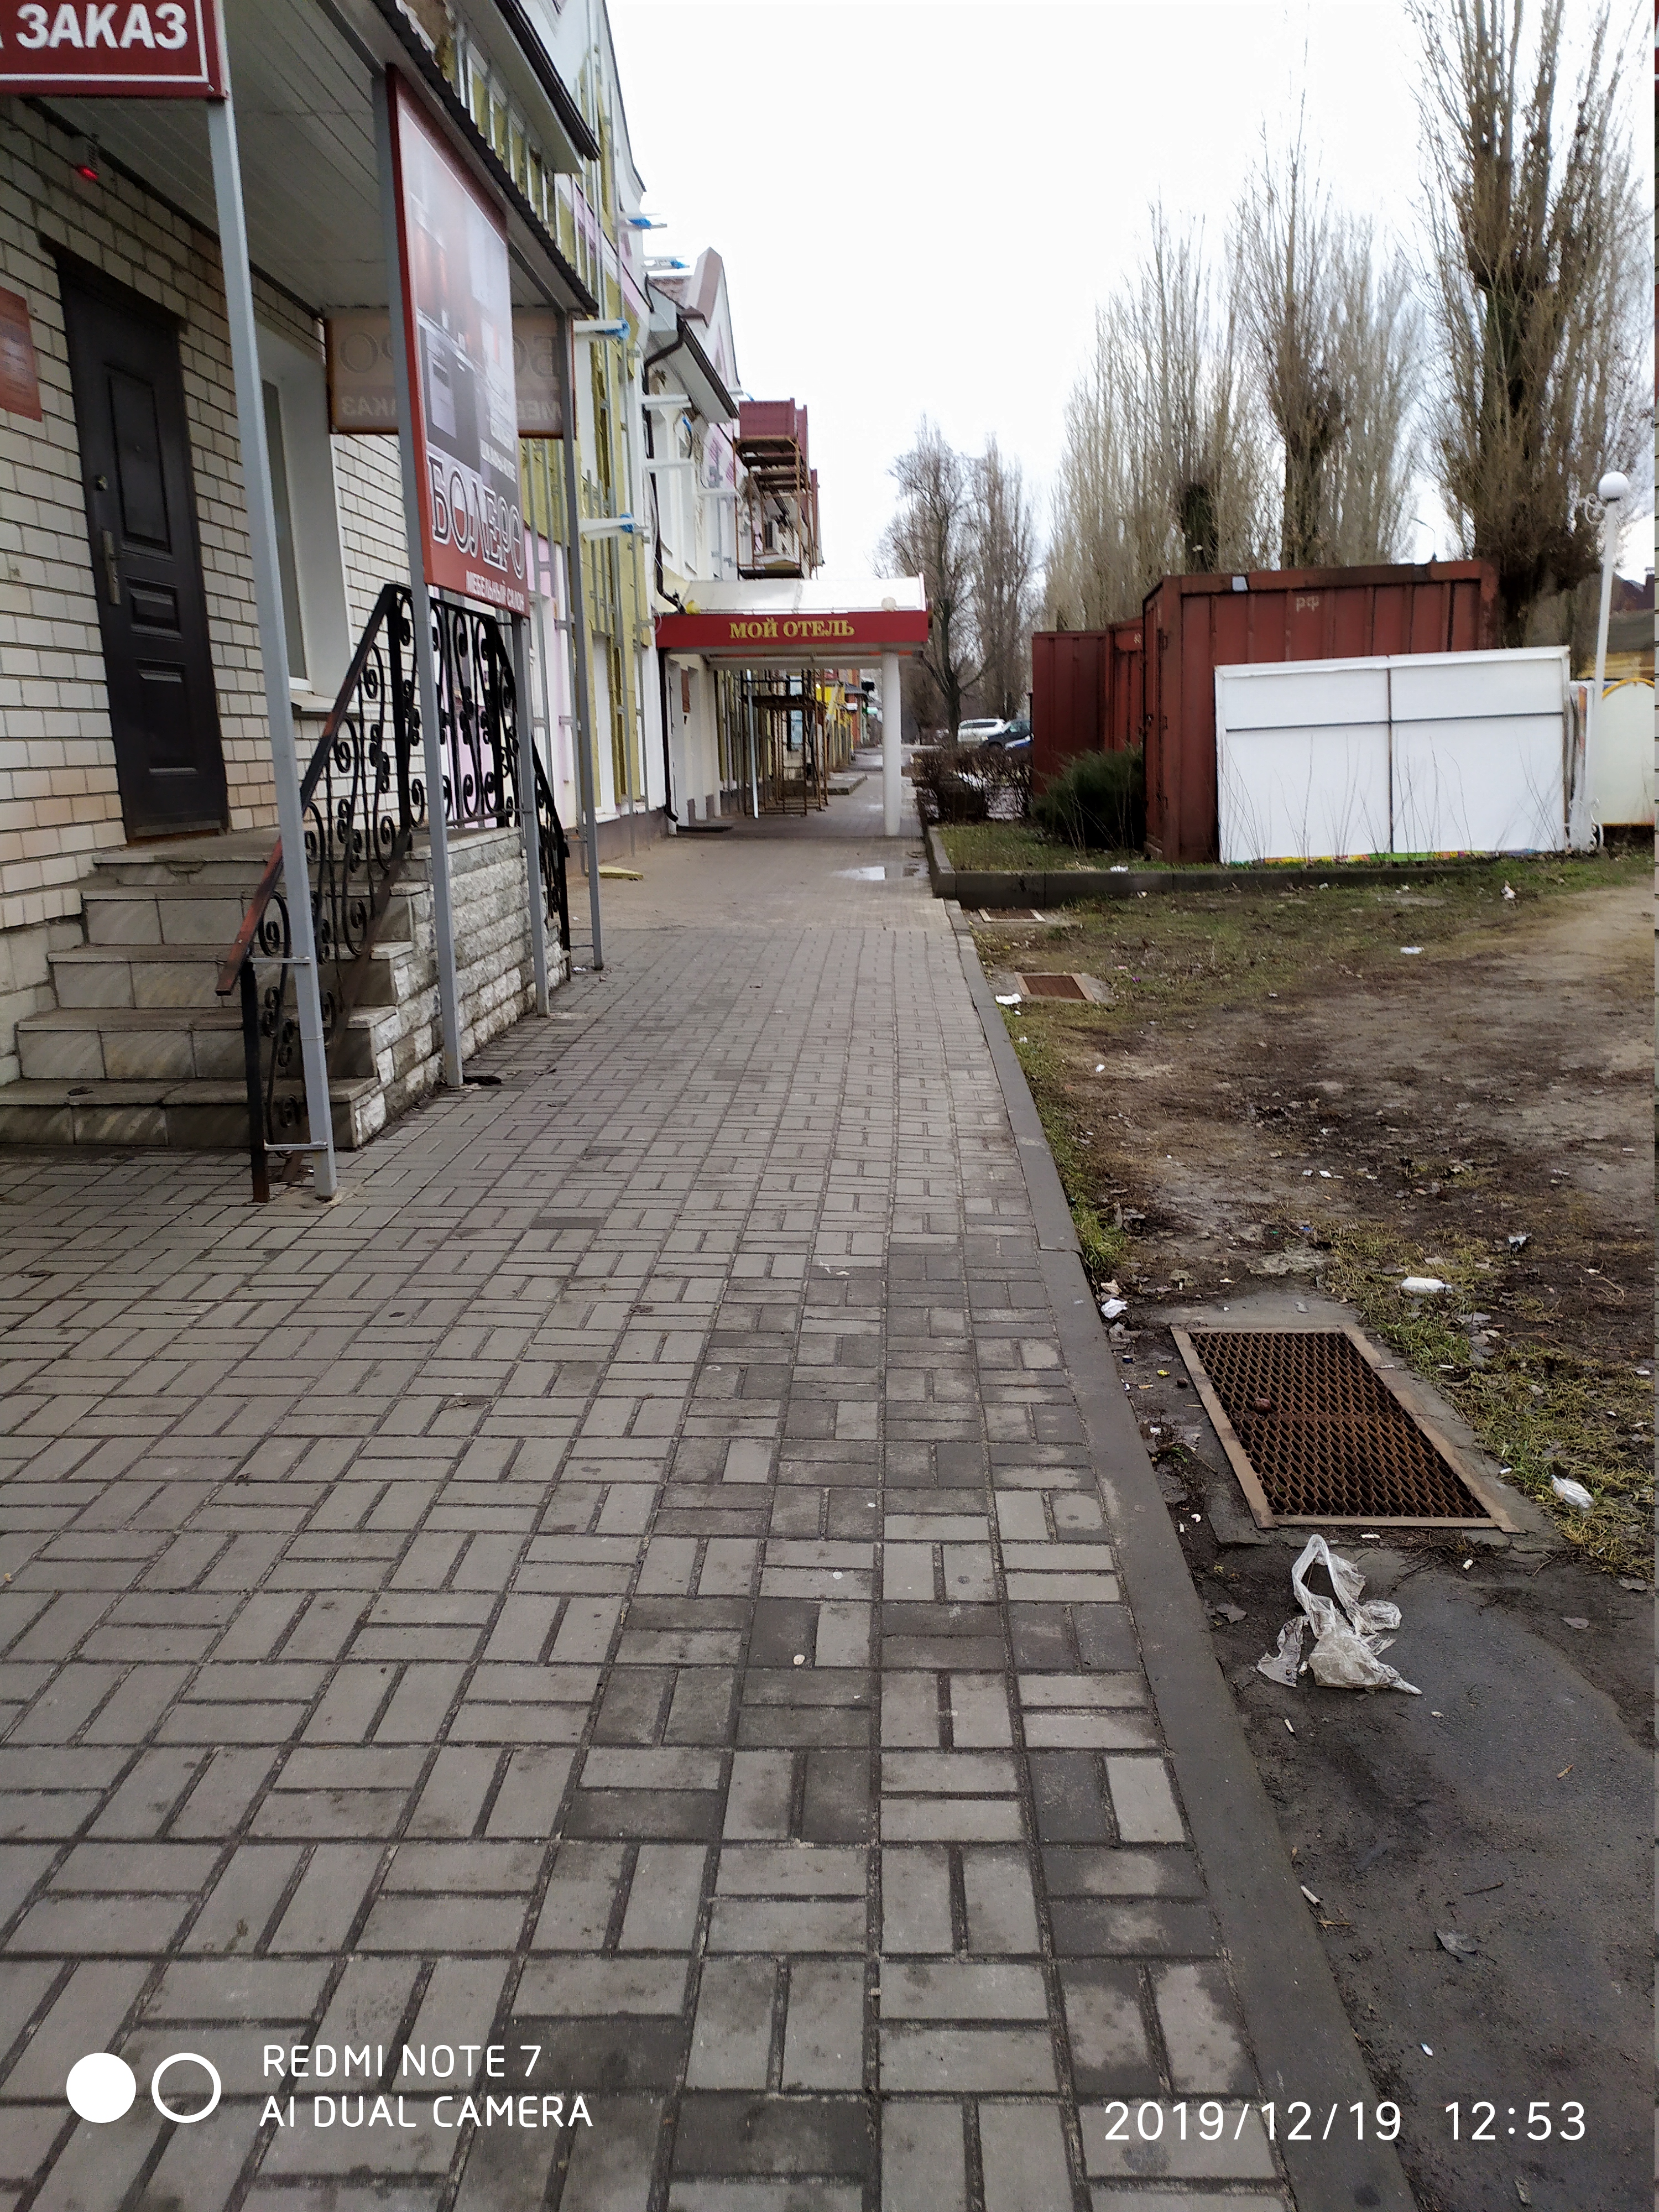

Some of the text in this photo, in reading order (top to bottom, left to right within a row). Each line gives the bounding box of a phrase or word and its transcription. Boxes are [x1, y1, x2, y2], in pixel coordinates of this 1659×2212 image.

[17, 3, 187, 49] ЗАКАЗ
[426, 451, 525, 580] БОЛЕРО
[729, 617, 855, 639] МОЙ ОТЕЛЬ
